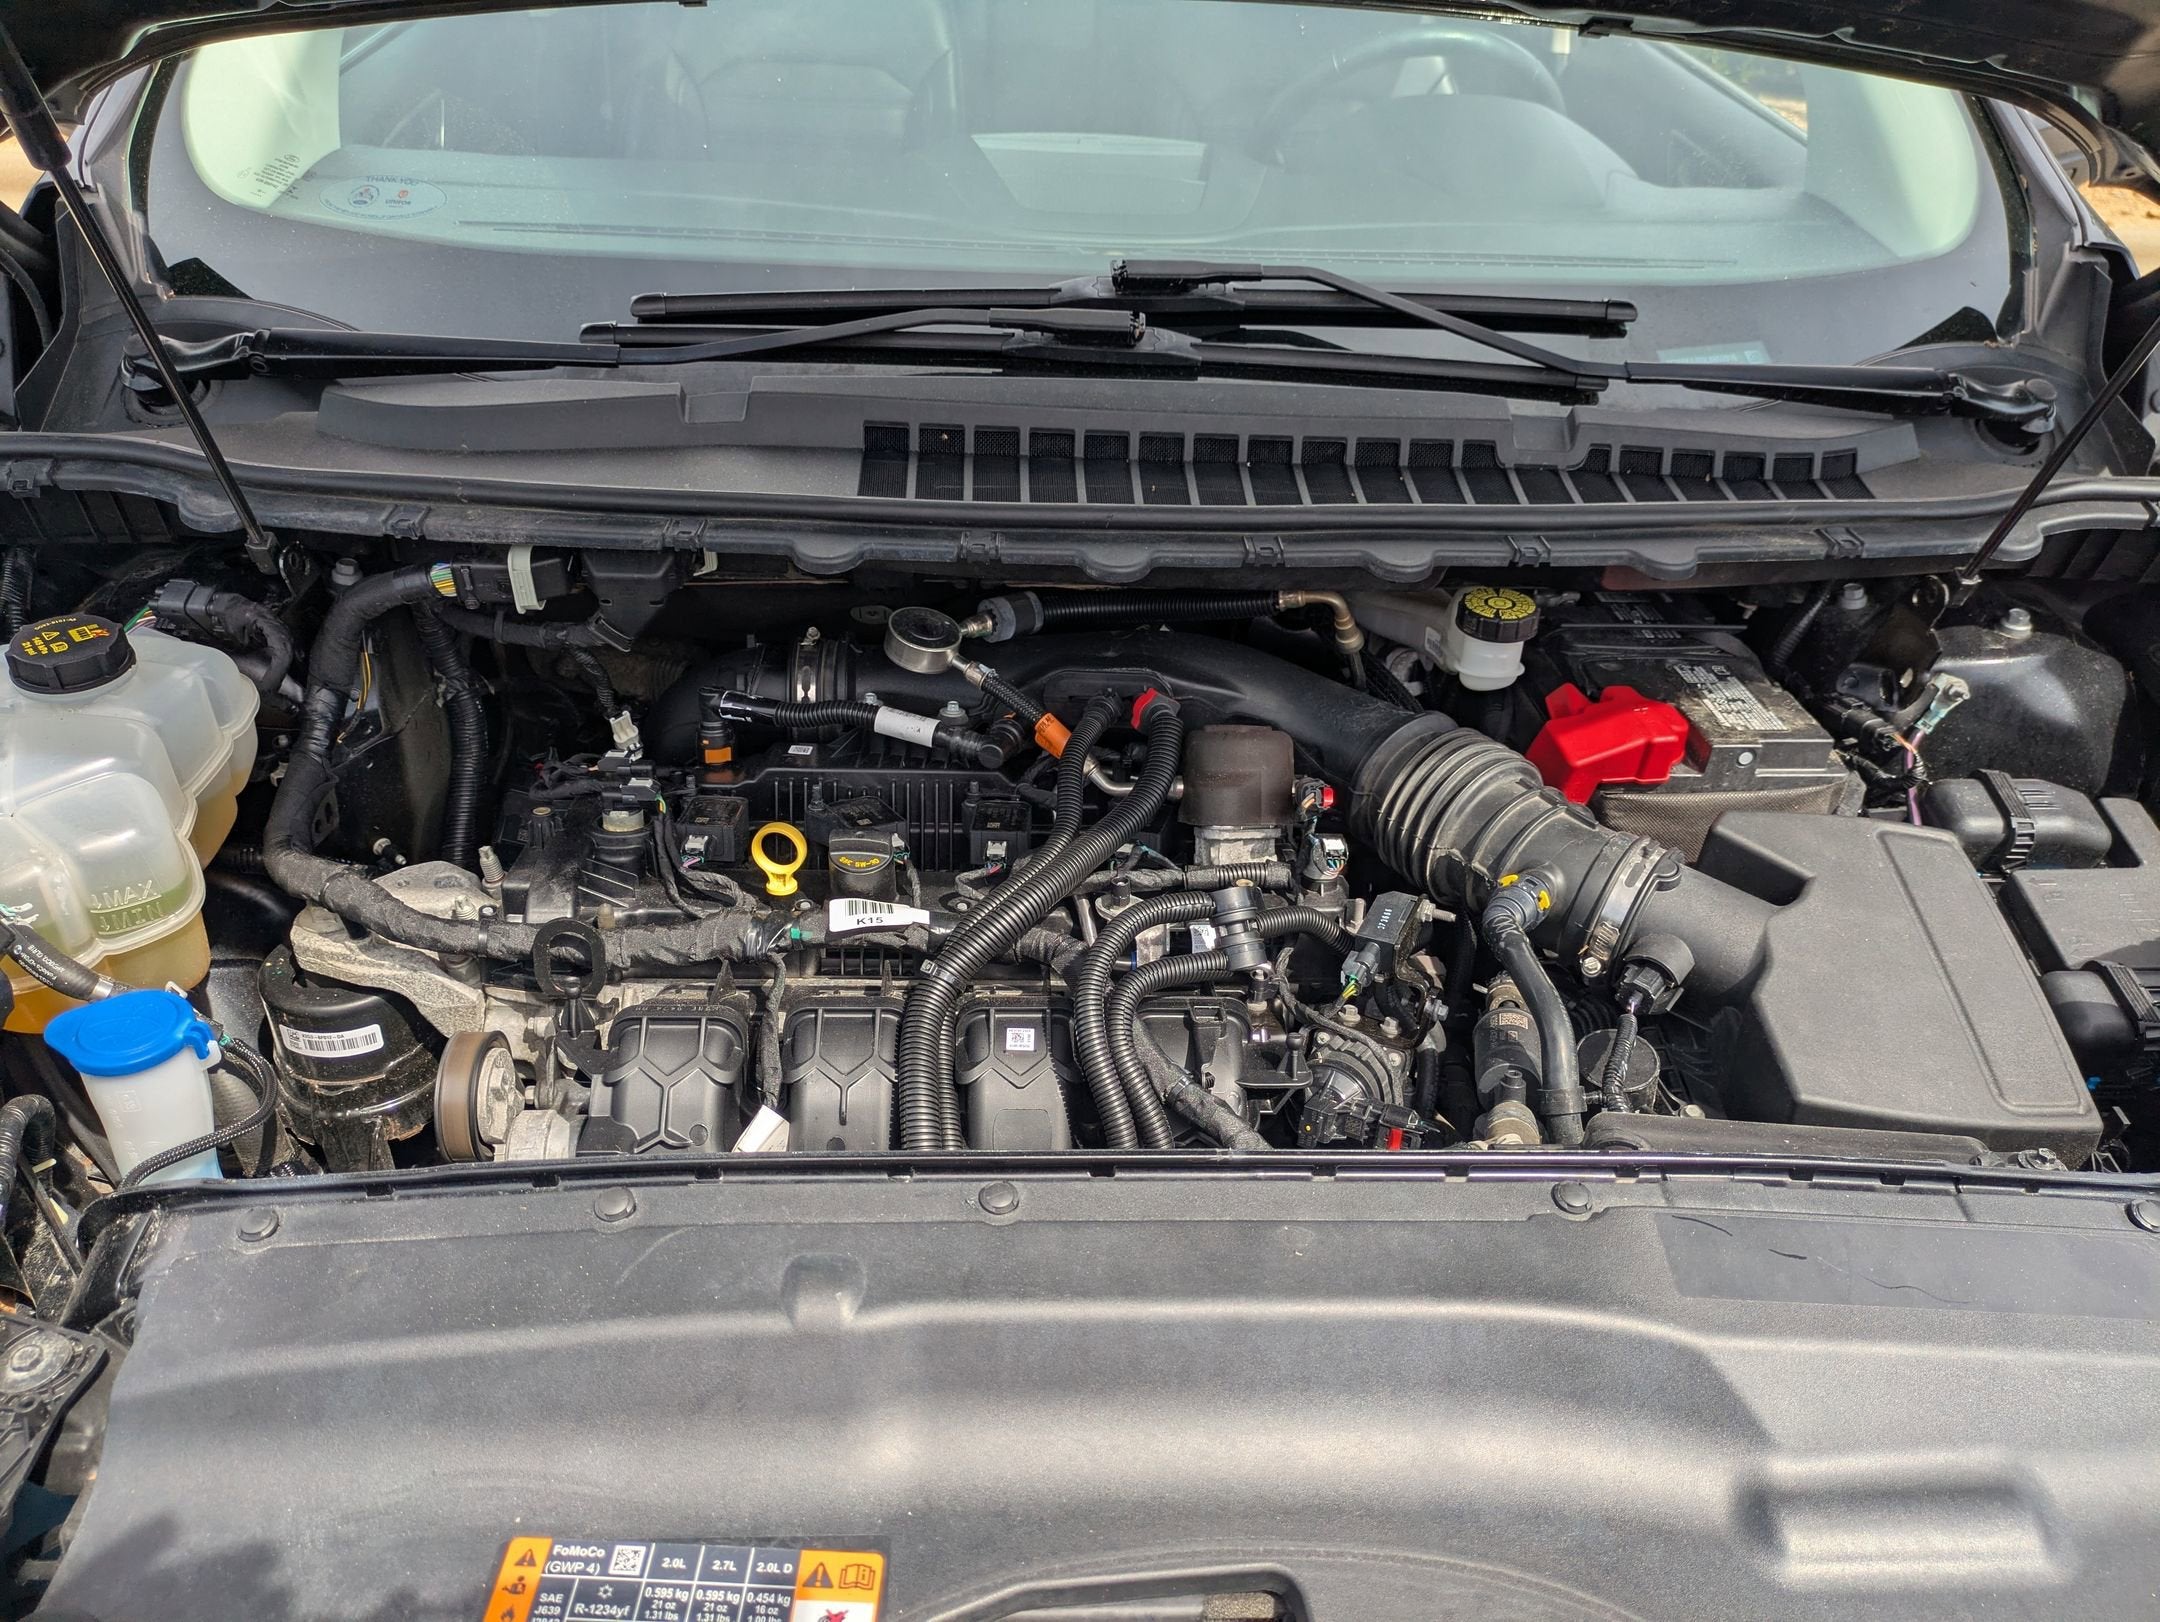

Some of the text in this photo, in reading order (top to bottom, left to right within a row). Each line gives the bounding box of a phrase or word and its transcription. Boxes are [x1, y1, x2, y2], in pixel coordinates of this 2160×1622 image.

[103, 880, 158, 907] MAX
[112, 902, 164, 931] MIN
[856, 916, 884, 926] K15
[552, 1544, 606, 1558] FoMoCo
[544, 1560, 601, 1576] (GWP 4)
[661, 1557, 687, 1570] 2.0L
[712, 1560, 737, 1571] 2.7L
[756, 1562, 793, 1574] 2.0L D
[540, 1592, 564, 1604] SAE
[644, 1586, 690, 1603] 0.595 kg
[695, 1588, 741, 1605] 0.595 kg
[746, 1592, 792, 1608] 0.454 kg
[534, 1604, 561, 1615] J639
[574, 1603, 631, 1618] R-1234yf
[651, 1600, 676, 1610] 21 oz
[703, 1602, 728, 1613] 21 oz
[755, 1604, 779, 1615] 16 oz
[644, 1609, 679, 1621] 1.31 lbs
[695, 1612, 731, 1622] 1.31 lbs
